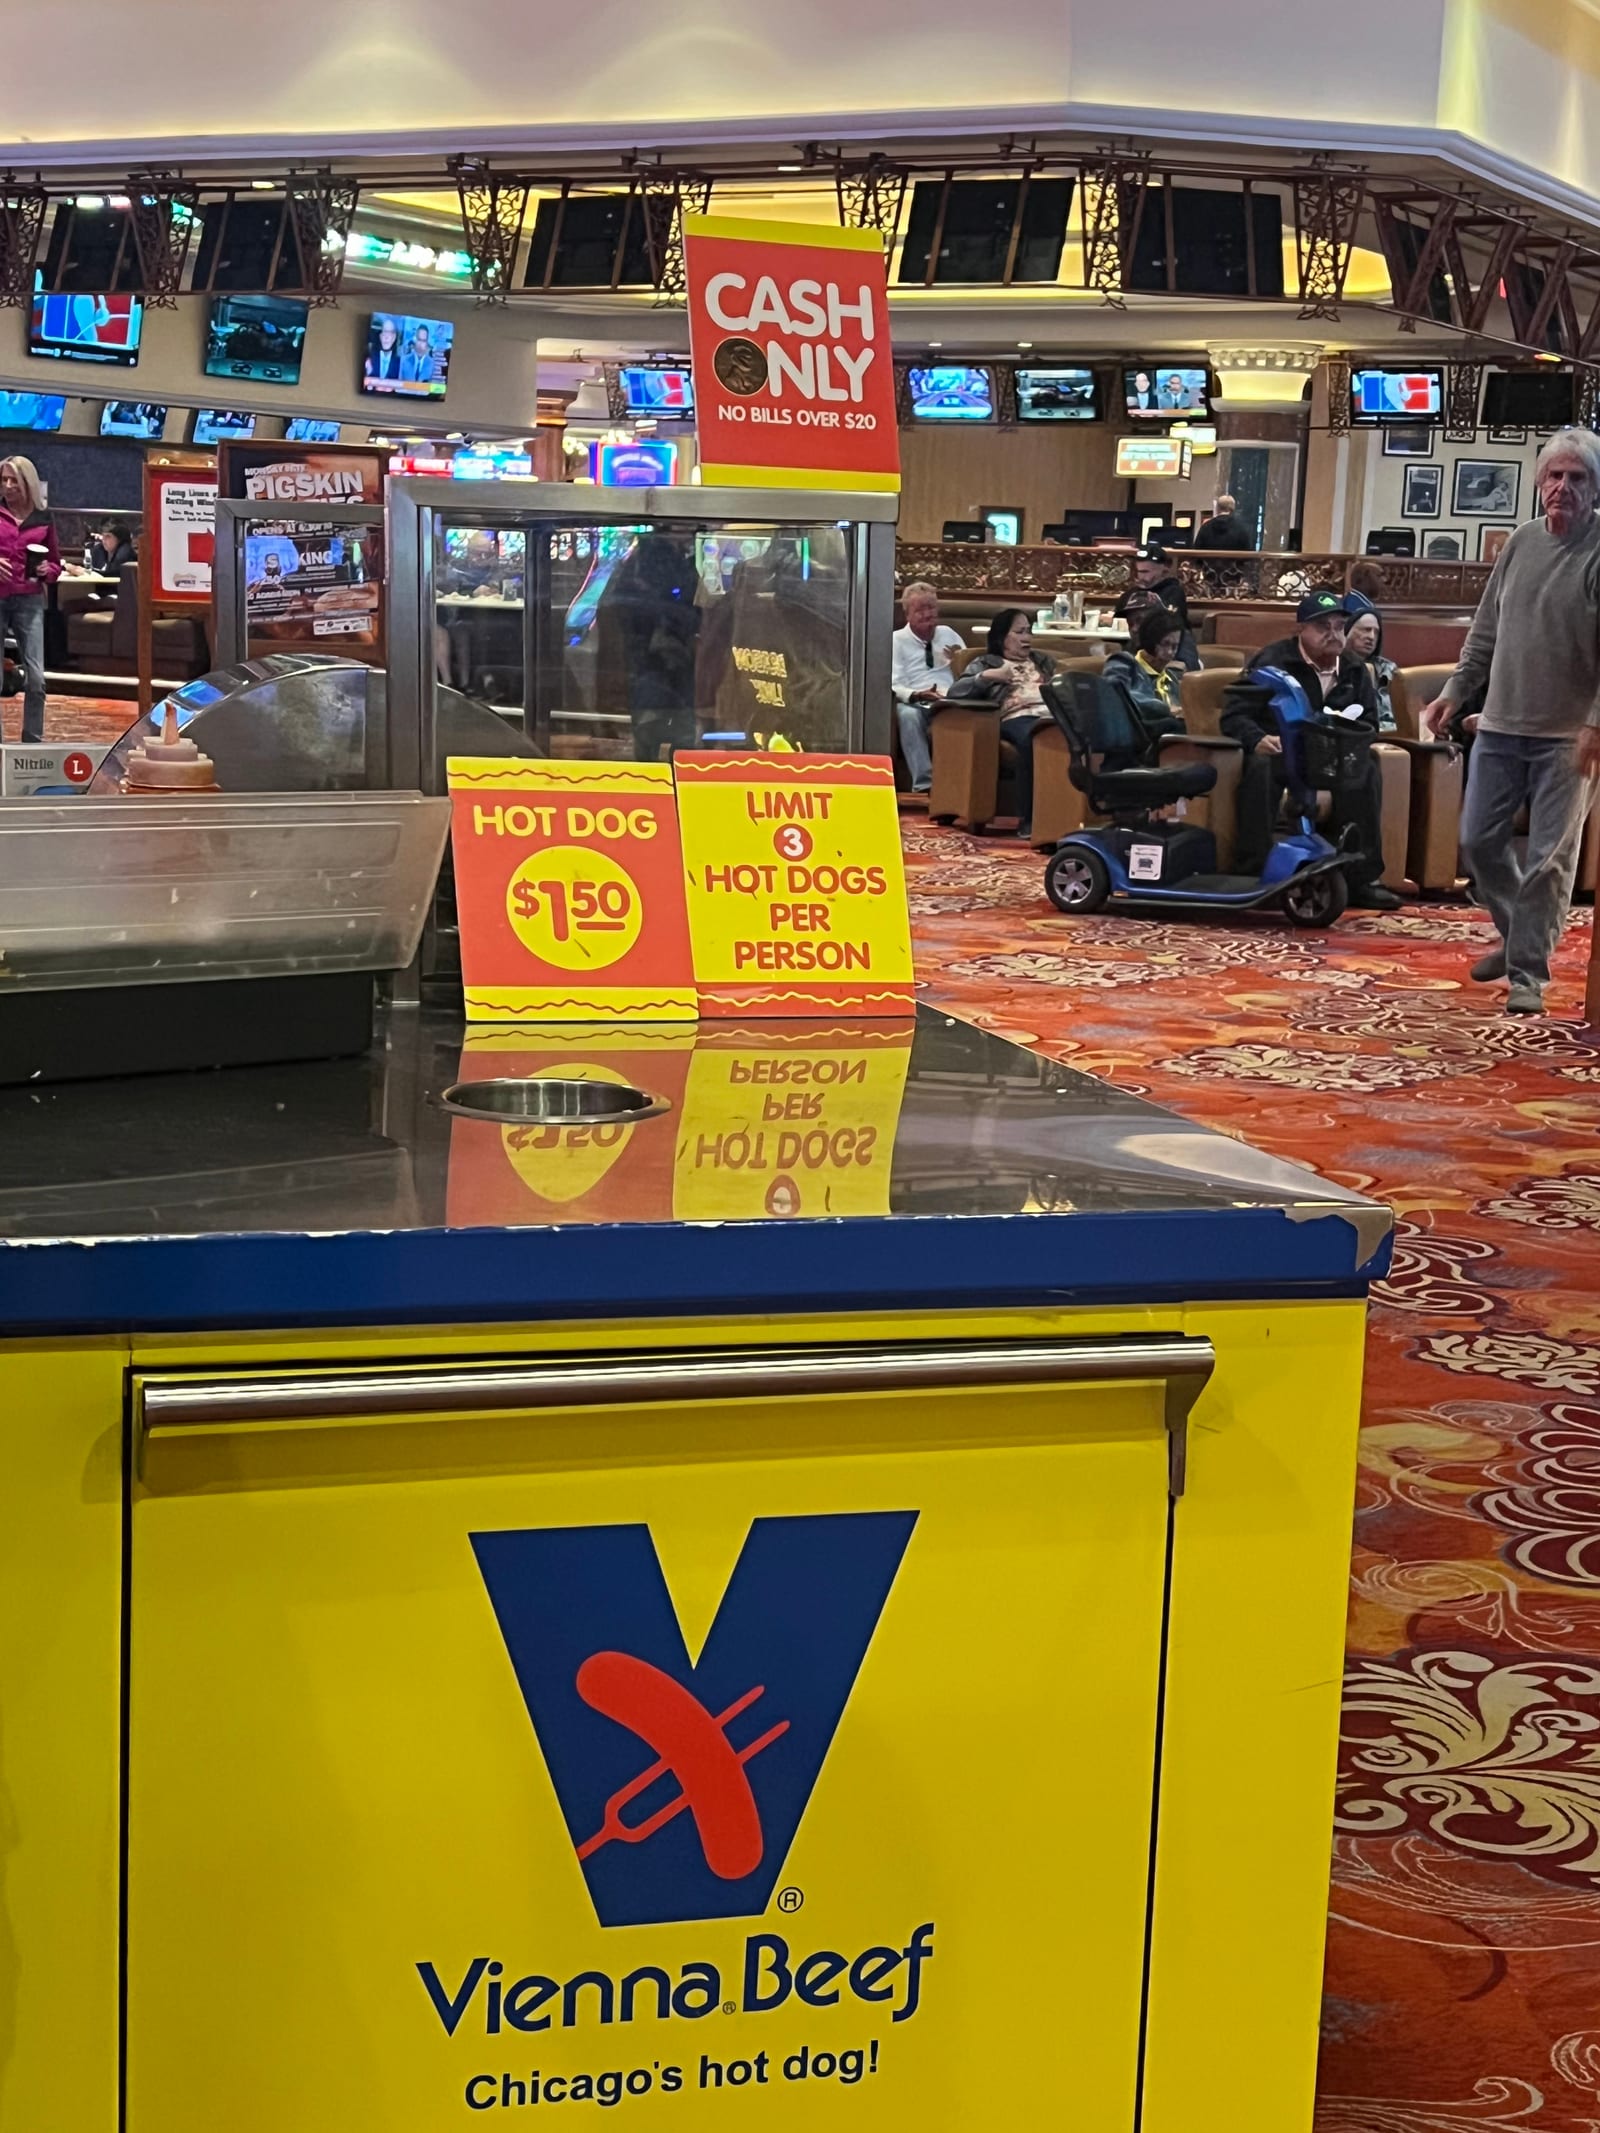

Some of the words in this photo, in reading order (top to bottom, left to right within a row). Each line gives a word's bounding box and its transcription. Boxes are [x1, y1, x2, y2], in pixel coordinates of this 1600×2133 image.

[705, 272, 874, 341] CASH
[718, 404, 746, 422] NO
[750, 407, 793, 425] BILLS
[796, 410, 840, 428] OVER
[844, 412, 877, 430] $20
[246, 471, 363, 500] PIGSKIN
[14, 758, 54, 771] Nitrile
[72, 760, 83, 775] L
[747, 791, 833, 820] LIMIT
[473, 805, 557, 837] HOT
[568, 808, 658, 839] DOG
[782, 827, 804, 857] 3
[705, 864, 778, 895] HOT
[788, 866, 887, 896] DOGS
[769, 903, 831, 932] PER
[734, 941, 871, 970] PERSON
[415, 1957, 721, 2038] Vienna
[743, 1922, 934, 2023] Beef
[465, 2061, 683, 2110] Chicago's
[699, 2050, 770, 2088] hot
[783, 2040, 880, 2083] dog!
